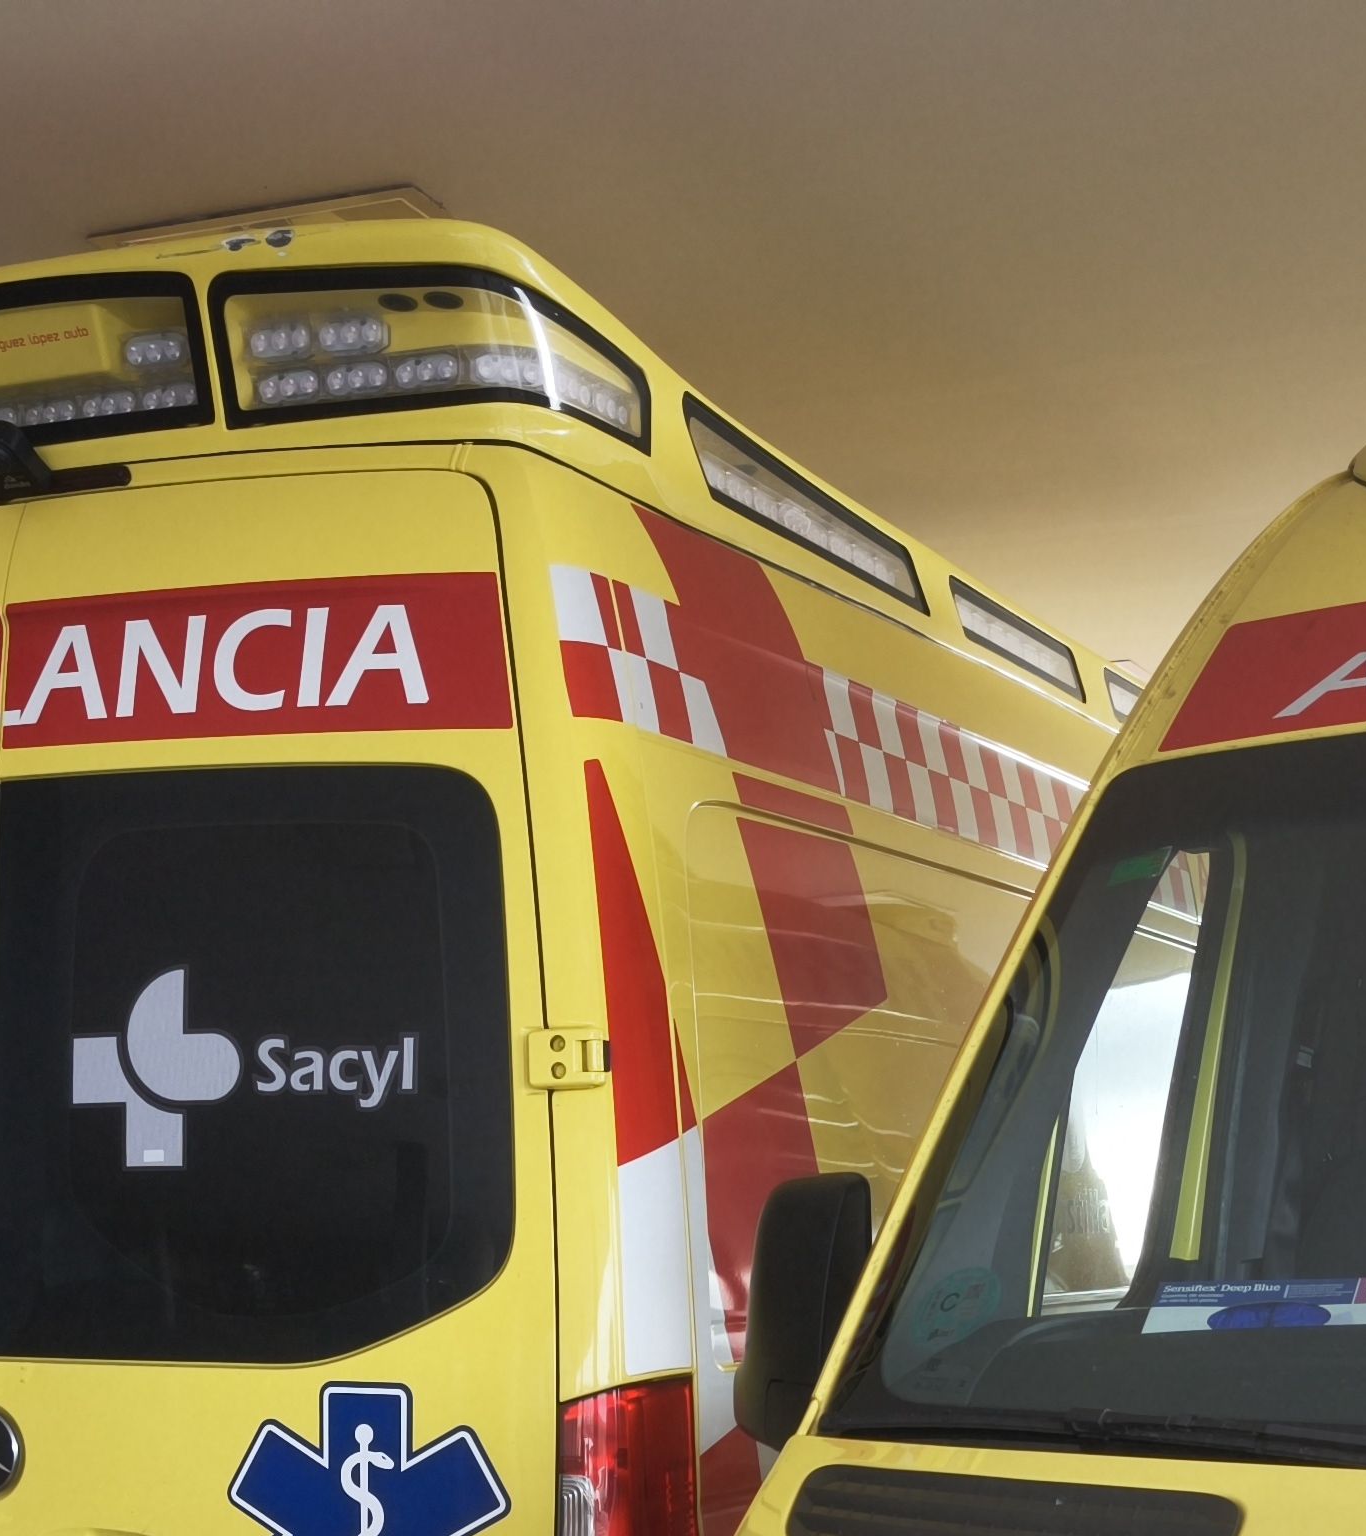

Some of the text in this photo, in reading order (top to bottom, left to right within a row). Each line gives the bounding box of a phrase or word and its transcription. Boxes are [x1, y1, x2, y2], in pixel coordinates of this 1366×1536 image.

[64, 326, 89, 339] auto
[256, 1037, 414, 1108] Sacyl
[1220, 1284, 1252, 1295] Deep
[1254, 1283, 1281, 1293] Blue
